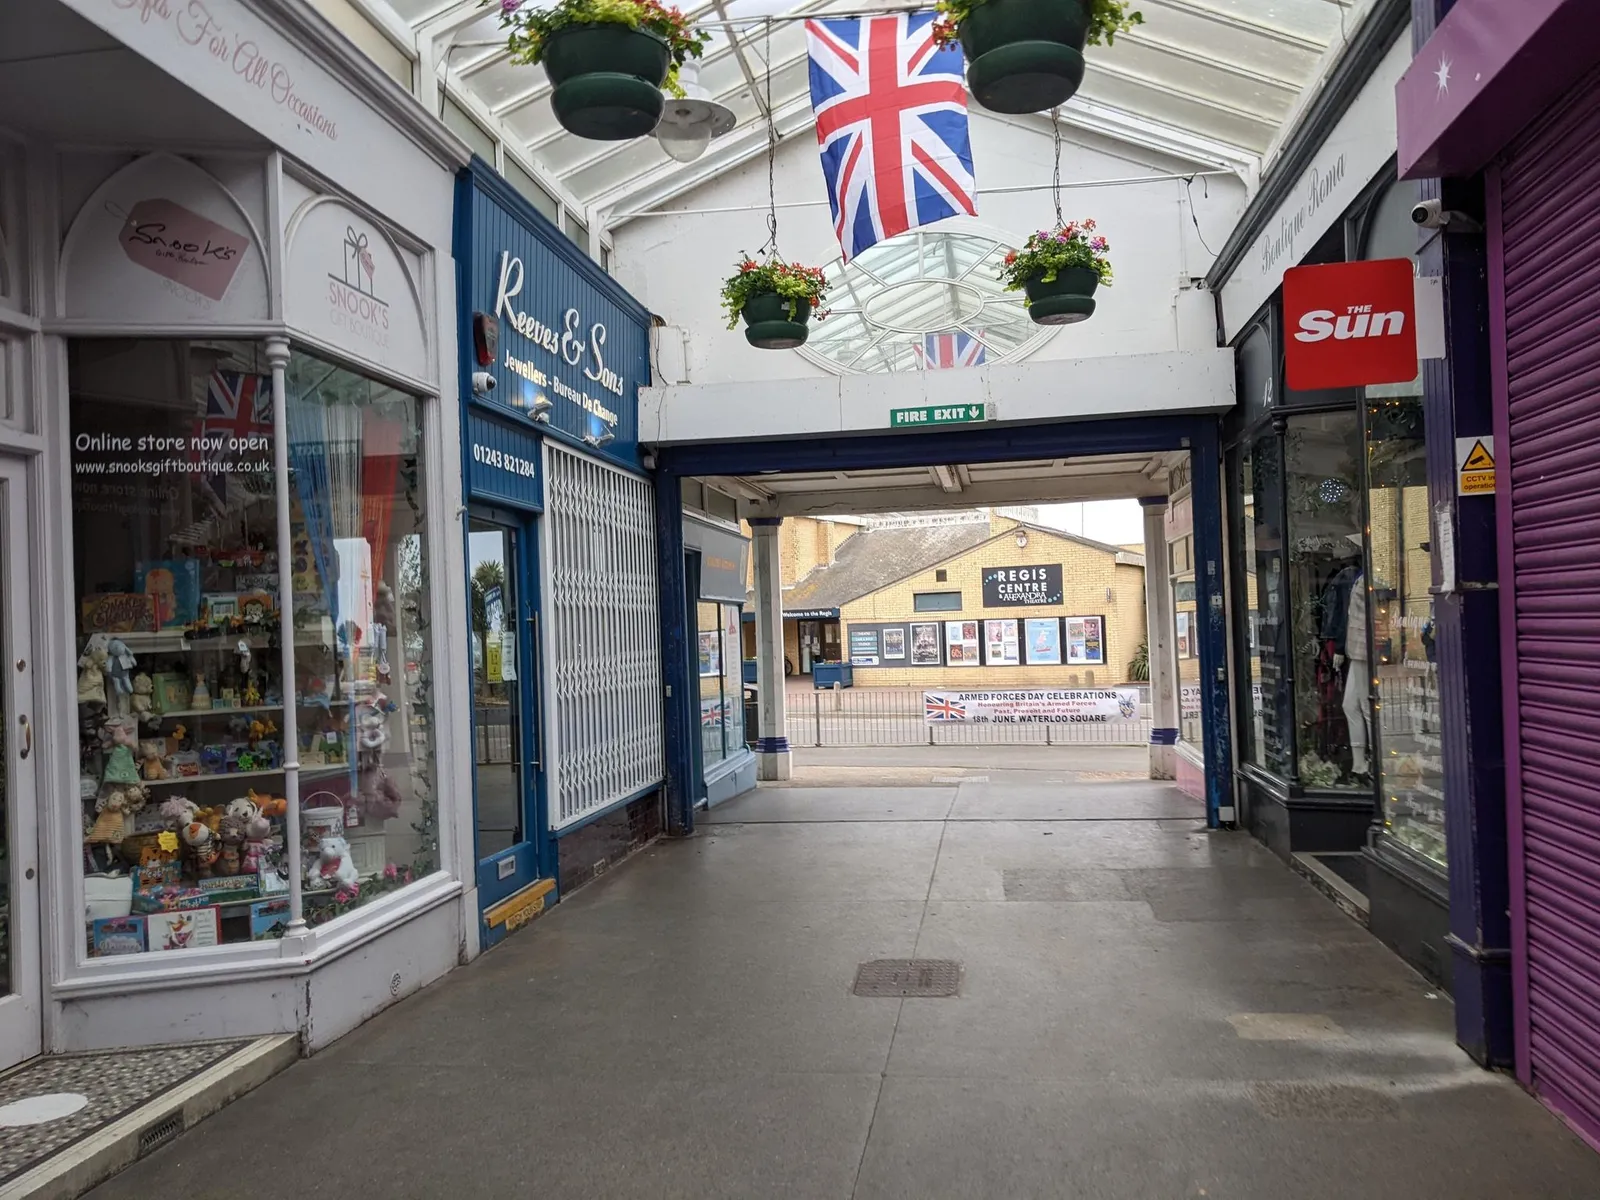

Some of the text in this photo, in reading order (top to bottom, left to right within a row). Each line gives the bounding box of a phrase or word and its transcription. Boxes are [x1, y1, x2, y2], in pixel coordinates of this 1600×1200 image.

[177, 0, 229, 62] For
[232, 33, 270, 89] All
[270, 62, 338, 141] Occasions
[1261, 153, 1346, 275] Boutique Roma
[329, 281, 389, 330] SNOOK'S
[1346, 304, 1373, 314] THE
[495, 251, 624, 396] Reeves & Sons
[1294, 309, 1405, 343] Sun
[504, 349, 547, 388] Jewellers
[553, 375, 582, 406] Bureau
[582, 392, 593, 413] De
[592, 399, 618, 427] Change
[896, 407, 966, 423] FIRE EXIT
[75, 432, 269, 456] Online store now open
[75, 458, 270, 477] www.snooksgiftboutique.co.uk
[473, 443, 535, 479] 01243 821284
[997, 568, 1047, 582] REGIS
[998, 582, 1047, 593] CENTRE
[1003, 592, 1047, 601] ALEXANDRA
[959, 691, 1117, 701] ARMED FORCES DAY CELEBRATIONS
[977, 701, 1014, 709] Honouring
[973, 715, 989, 723] 18th
[992, 714, 1016, 723] JUNE
[1019, 714, 1068, 723] WATERLOO
[1070, 714, 1107, 722] SQUARE
